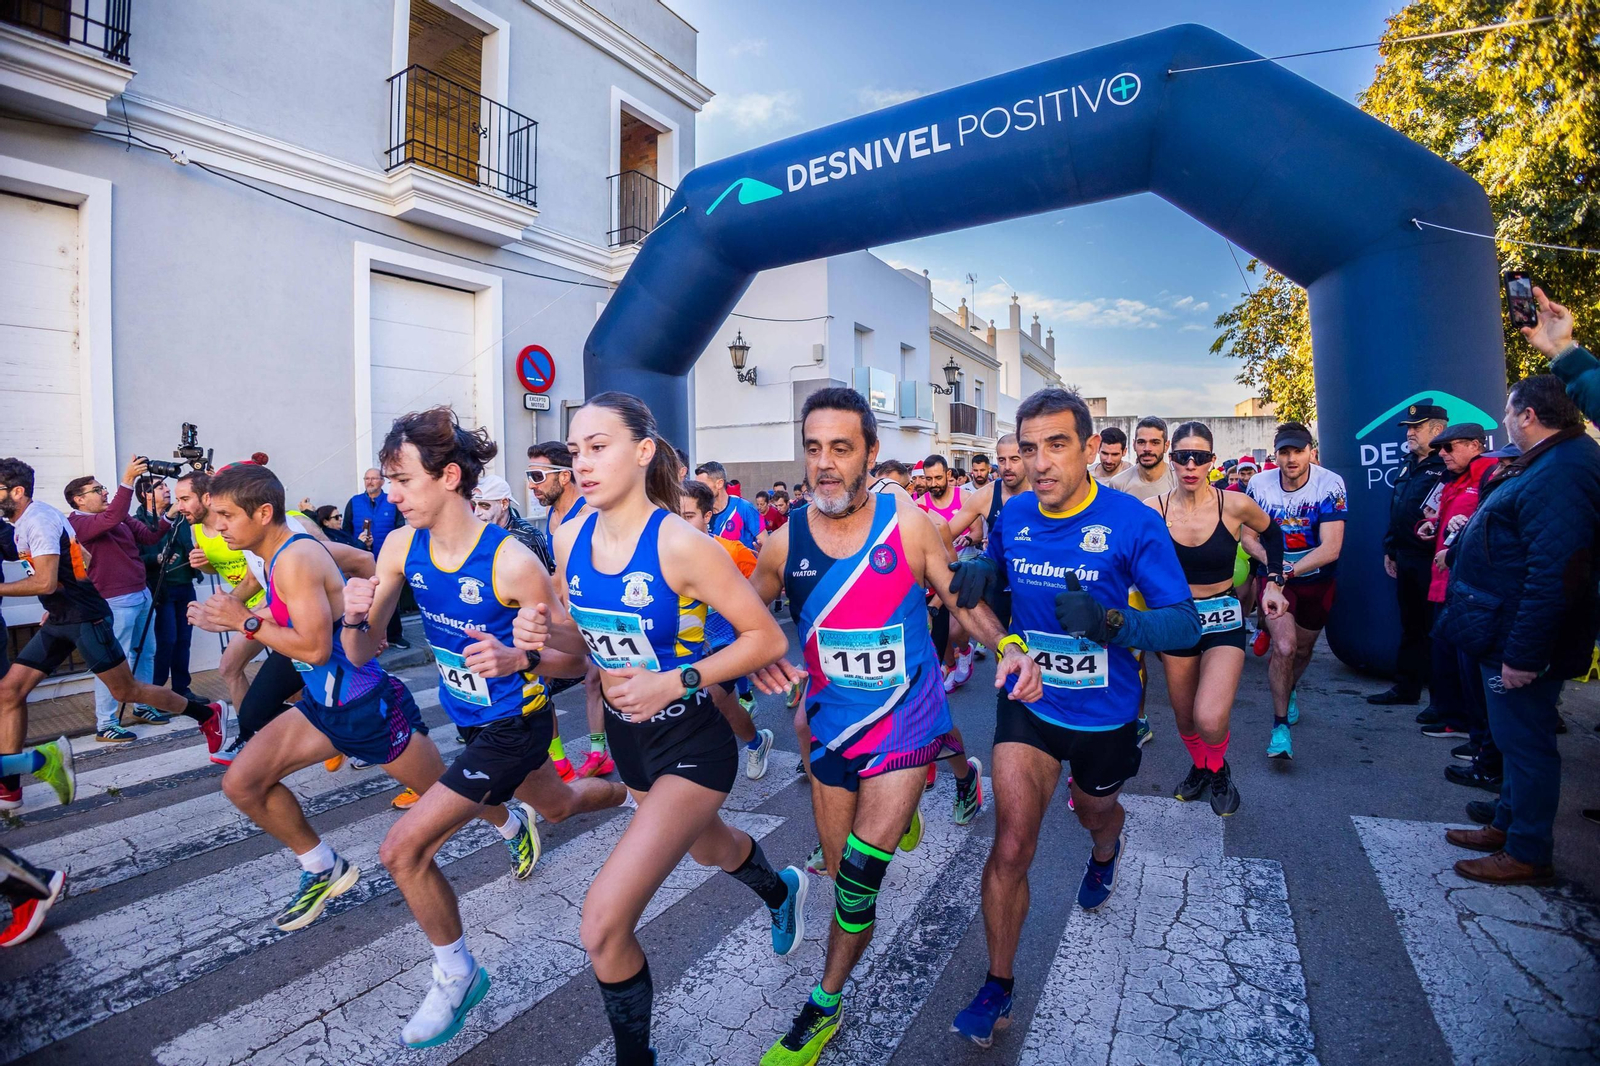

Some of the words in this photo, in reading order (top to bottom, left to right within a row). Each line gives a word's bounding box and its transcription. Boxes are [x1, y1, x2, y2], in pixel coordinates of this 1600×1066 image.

[787, 124, 951, 193] DESNIVEL
[1026, 578, 1043, 587] Piedra
[1043, 580, 1067, 590] Pikachos
[581, 629, 641, 656] 311
[832, 649, 896, 674] 119
[1034, 651, 1097, 674] 434
[848, 680, 876, 688] cajasur
[1049, 677, 1075, 686] cajasur
[638, 704, 686, 724] RO
